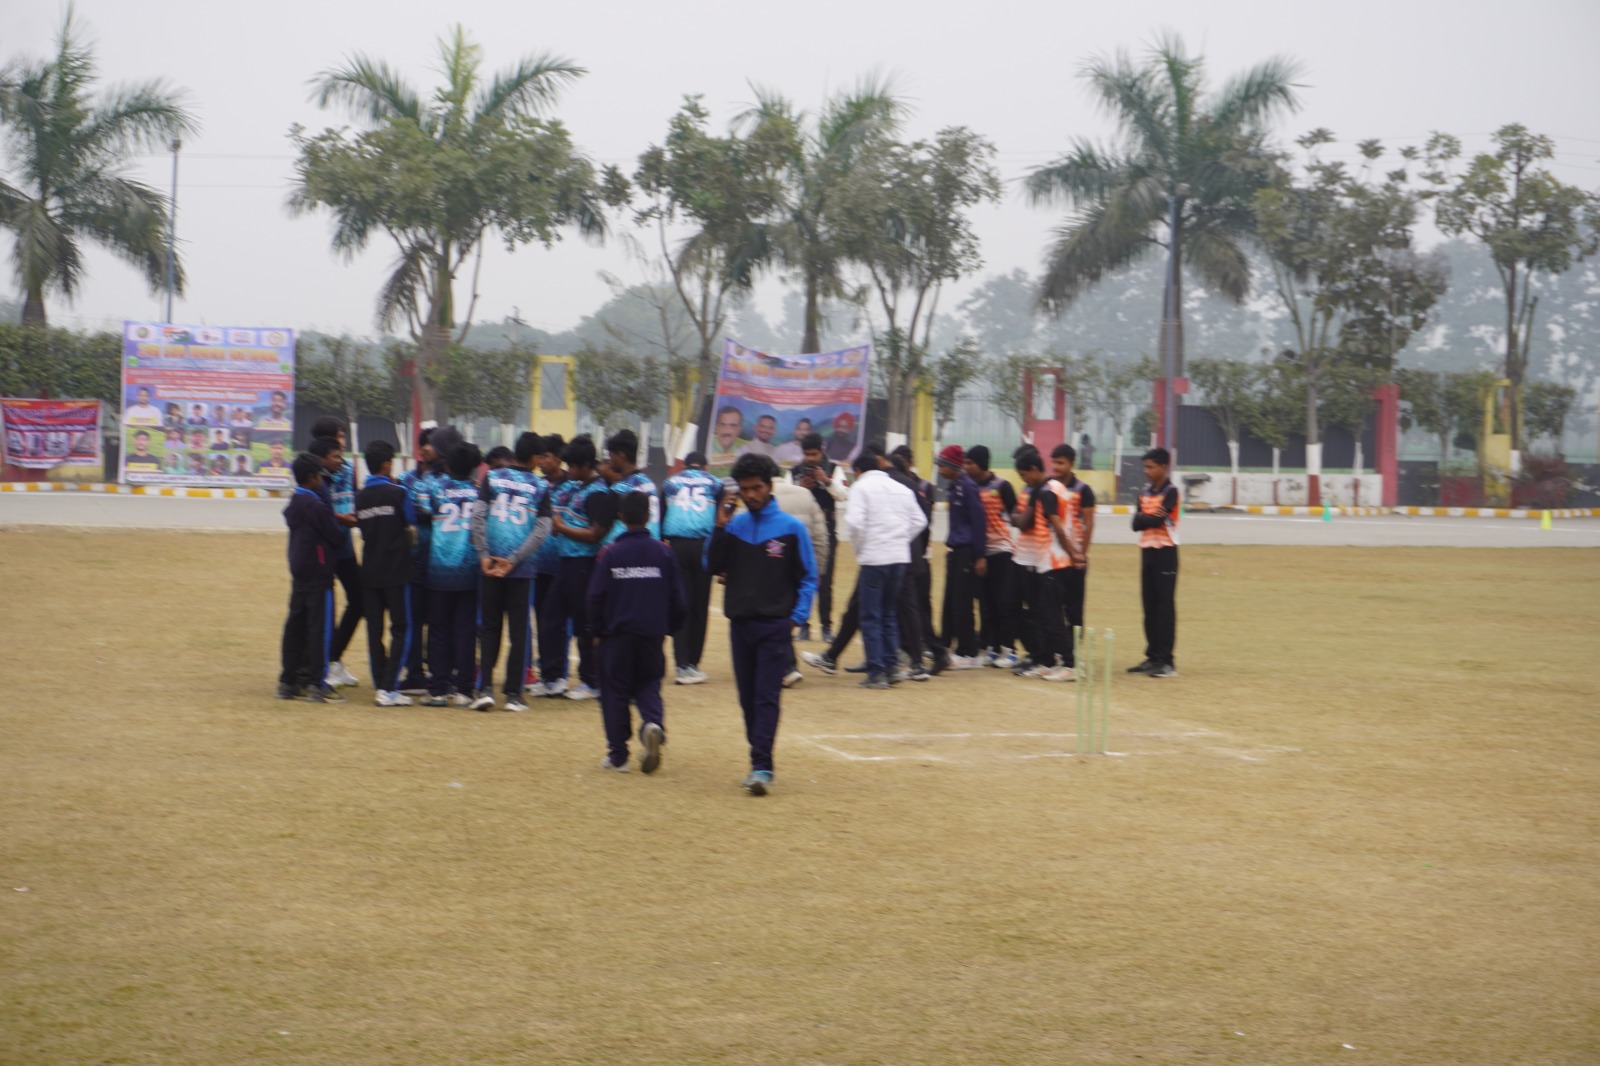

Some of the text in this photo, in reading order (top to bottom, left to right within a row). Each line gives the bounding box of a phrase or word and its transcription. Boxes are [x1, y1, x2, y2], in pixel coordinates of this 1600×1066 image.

[489, 492, 529, 525] 45
[674, 486, 708, 512] 45
[438, 501, 475, 532] 25
